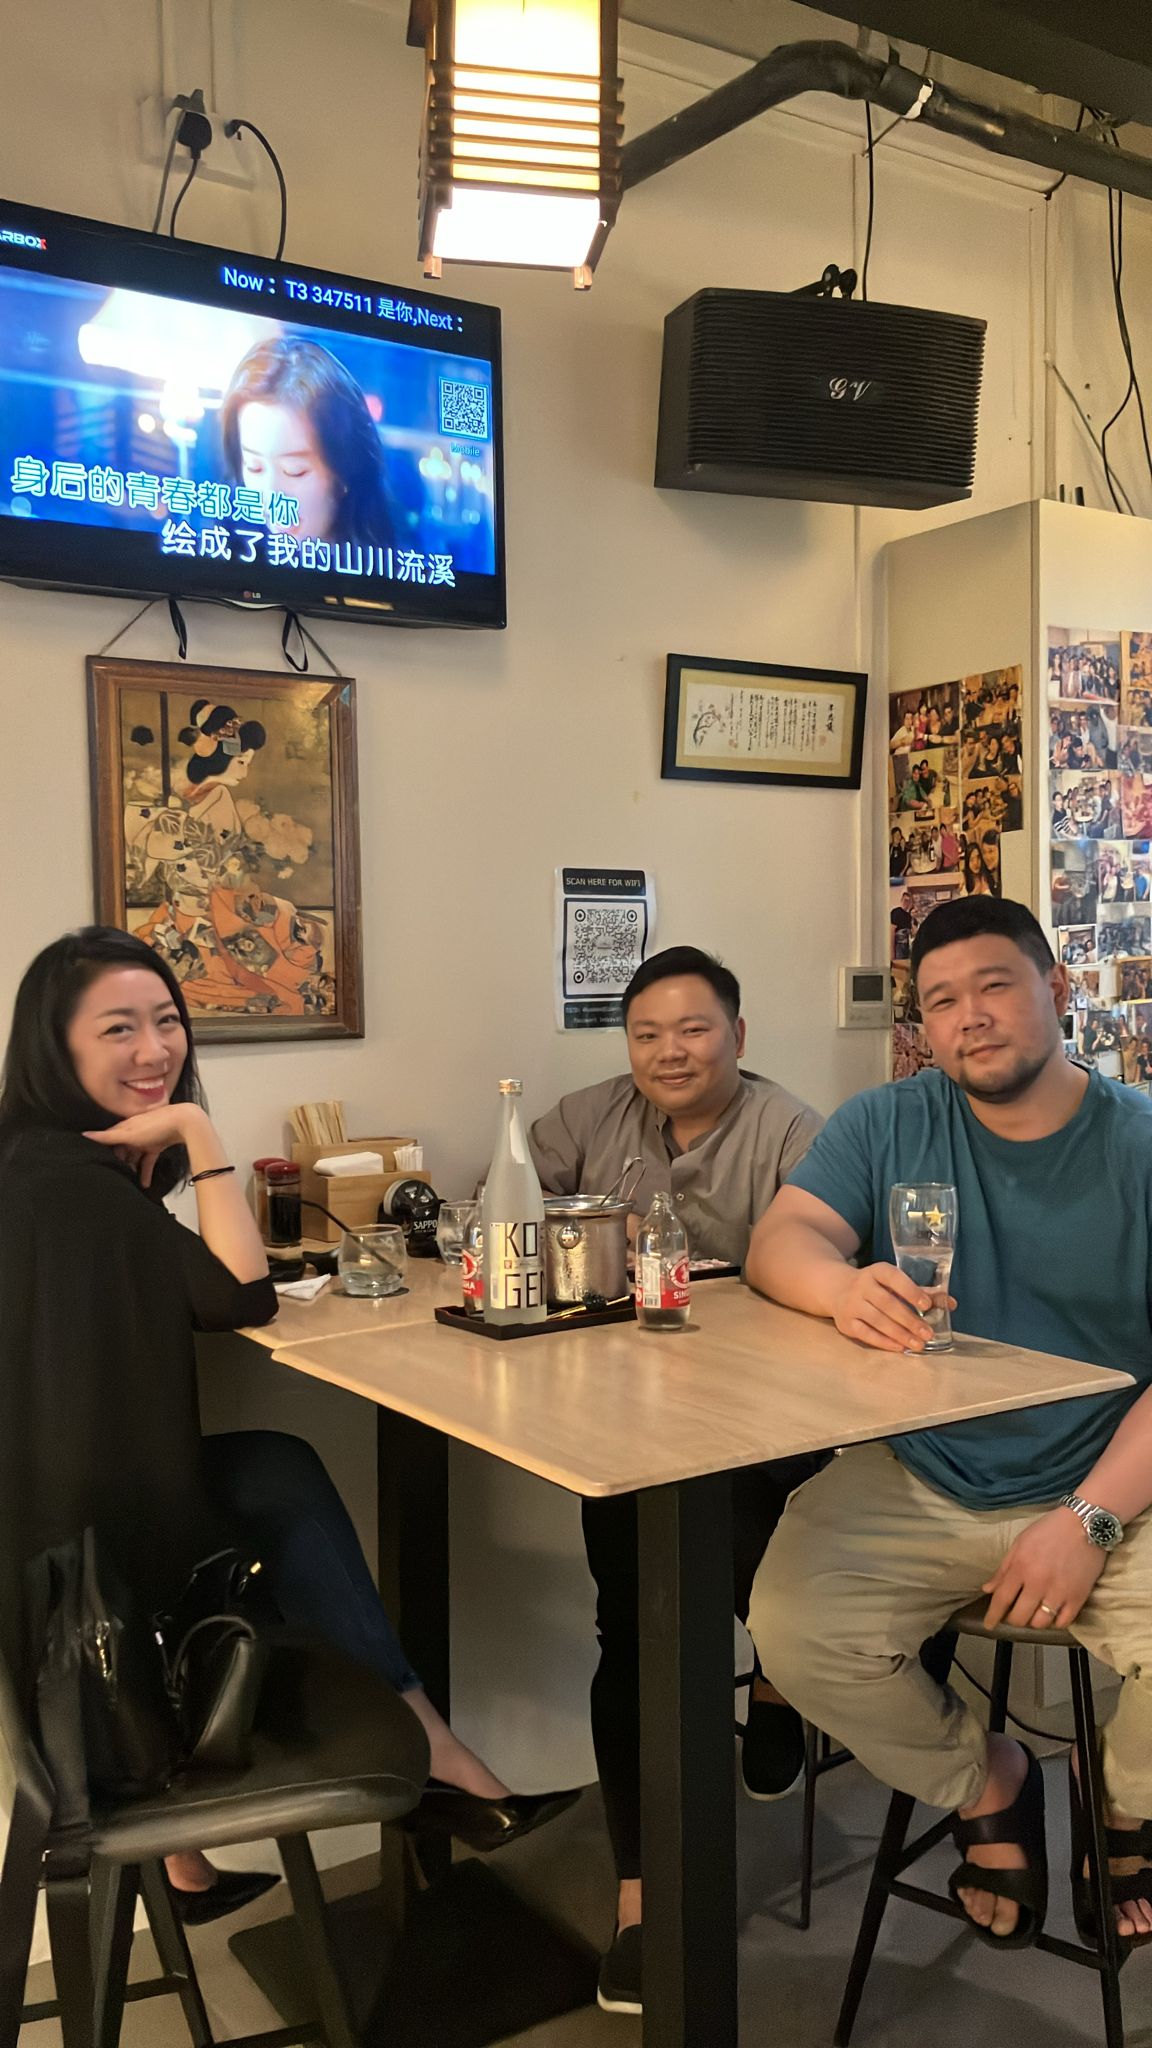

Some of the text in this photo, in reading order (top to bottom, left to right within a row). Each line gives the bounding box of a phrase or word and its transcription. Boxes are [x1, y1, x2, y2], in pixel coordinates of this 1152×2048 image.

[0, 230, 47, 250] RBOX
[286, 279, 307, 300] T3
[312, 286, 373, 315] 347511
[10, 456, 299, 527] 身后的青春都是你
[161, 518, 456, 588] 绘成了我的山川流溪
[566, 877, 586, 886] SCAN
[588, 878, 606, 887] HERE
[608, 878, 623, 887] FOR
